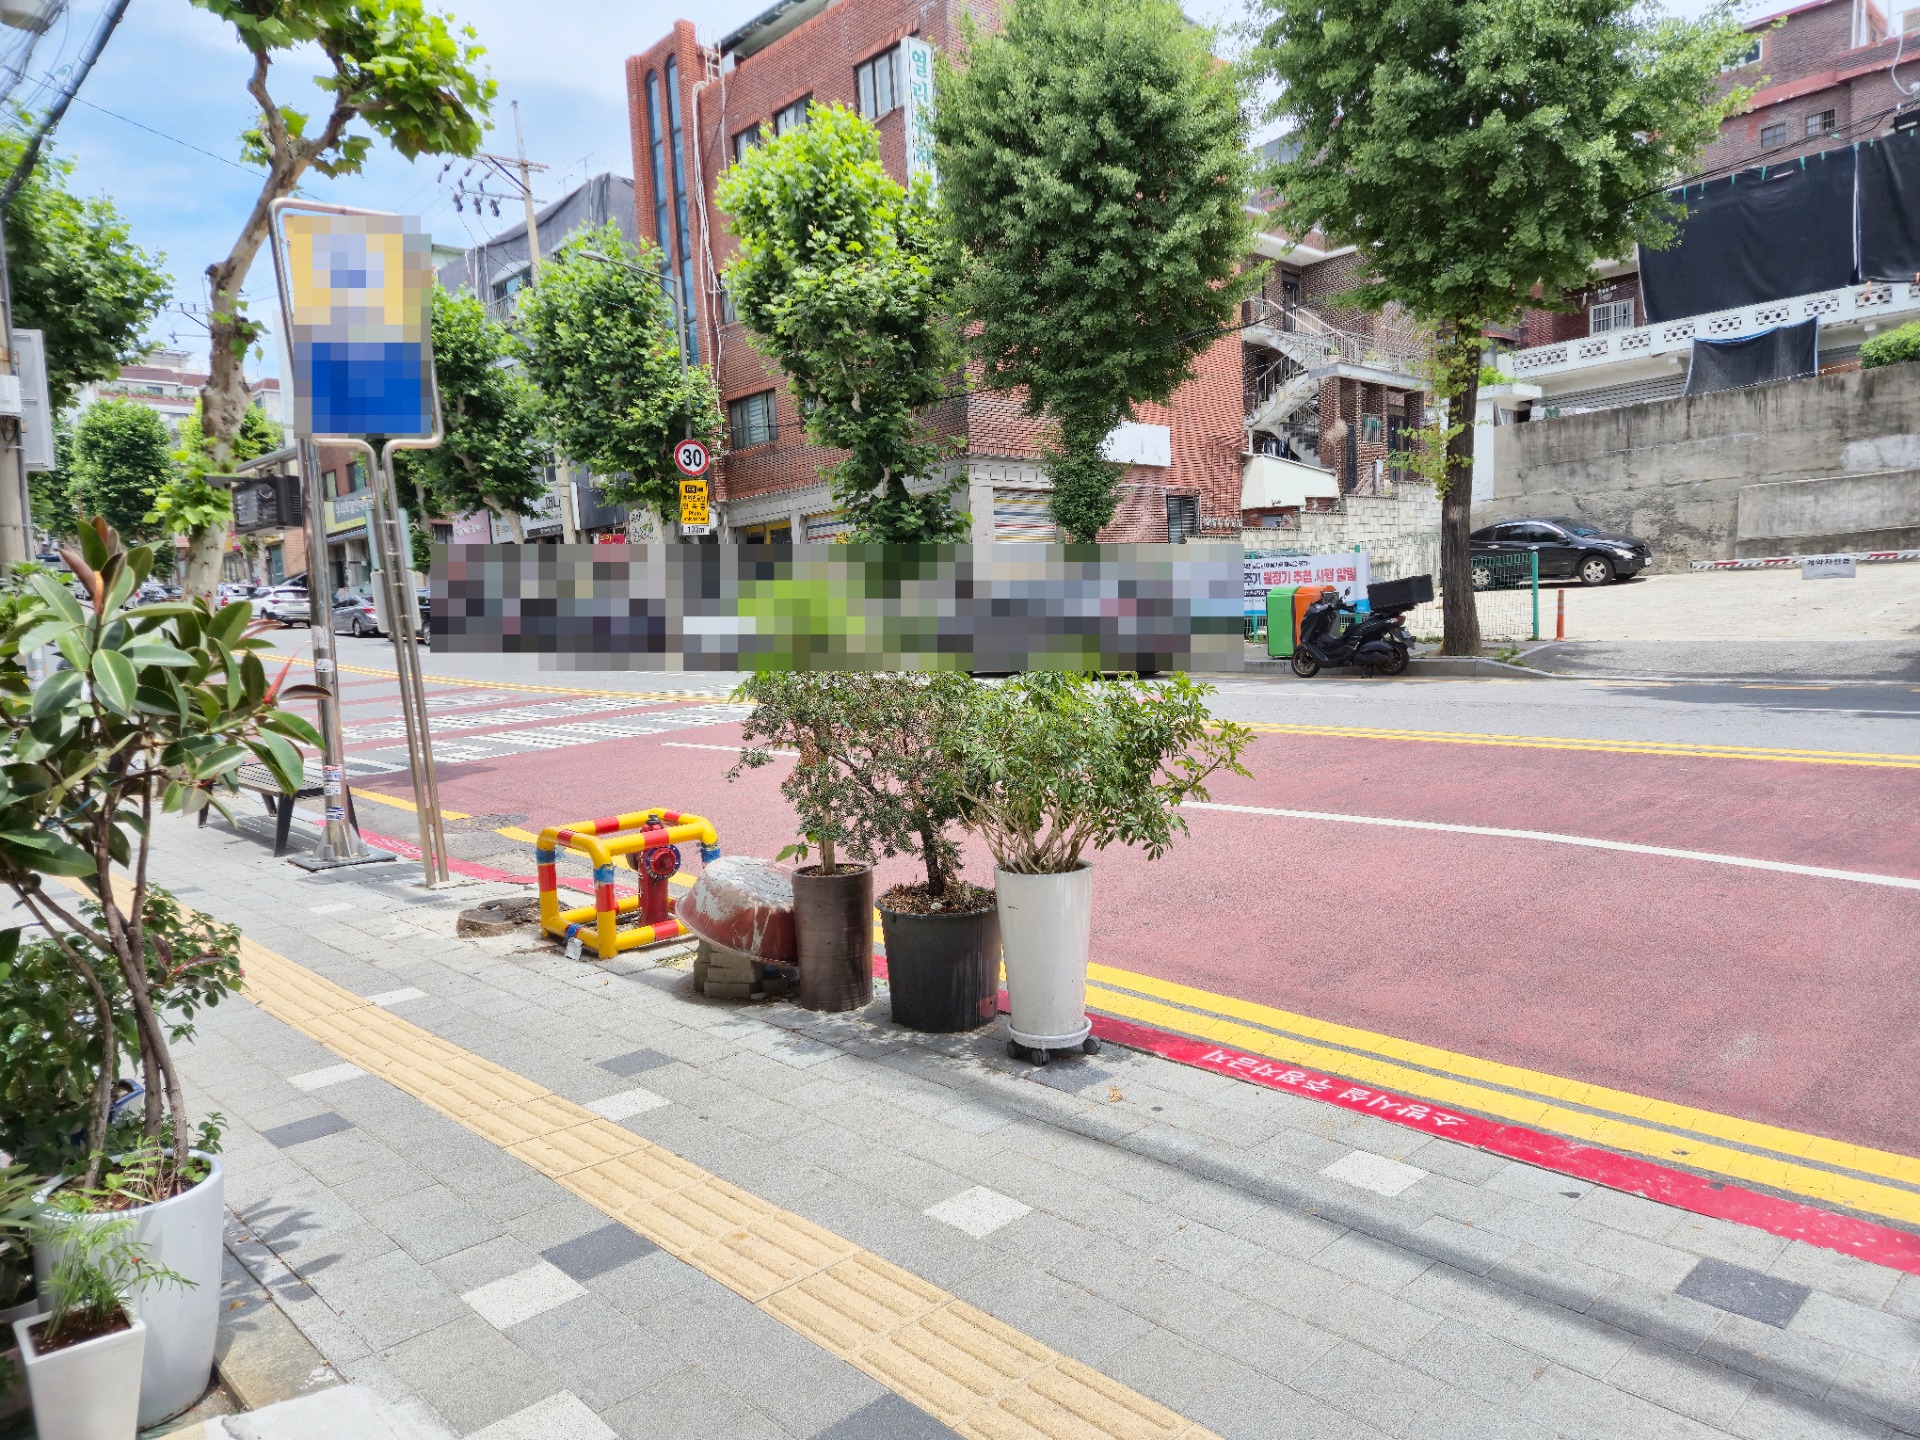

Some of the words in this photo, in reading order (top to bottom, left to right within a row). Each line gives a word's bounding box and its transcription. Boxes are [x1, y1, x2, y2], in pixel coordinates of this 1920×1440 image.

[682, 448, 702, 467] 30
[1264, 570, 1291, 585] 월정기
[1293, 569, 1312, 584] 추첨
[1315, 568, 1334, 583] 시행
[1336, 567, 1357, 582] 알림
[1201, 1050, 1333, 1092] 주정차금지
[1337, 1087, 1469, 1126] 소방시설
